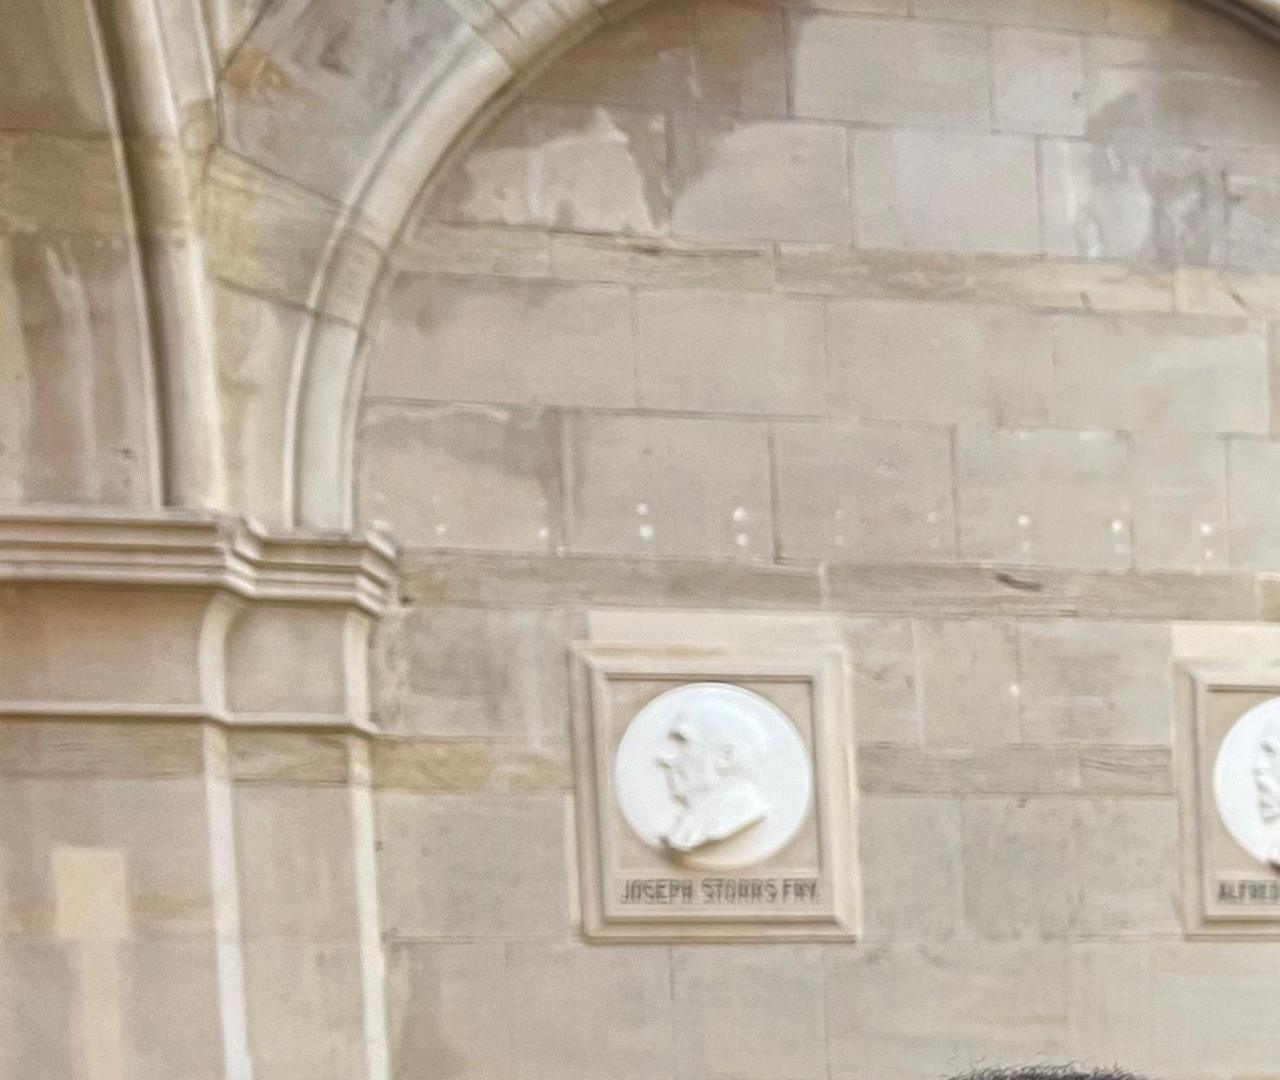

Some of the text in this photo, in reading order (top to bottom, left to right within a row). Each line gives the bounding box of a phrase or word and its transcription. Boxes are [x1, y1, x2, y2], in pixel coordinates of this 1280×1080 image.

[622, 879, 692, 904] JOSEPH
[701, 879, 777, 904] STORRS
[1217, 880, 1280, 904] ALFRED
